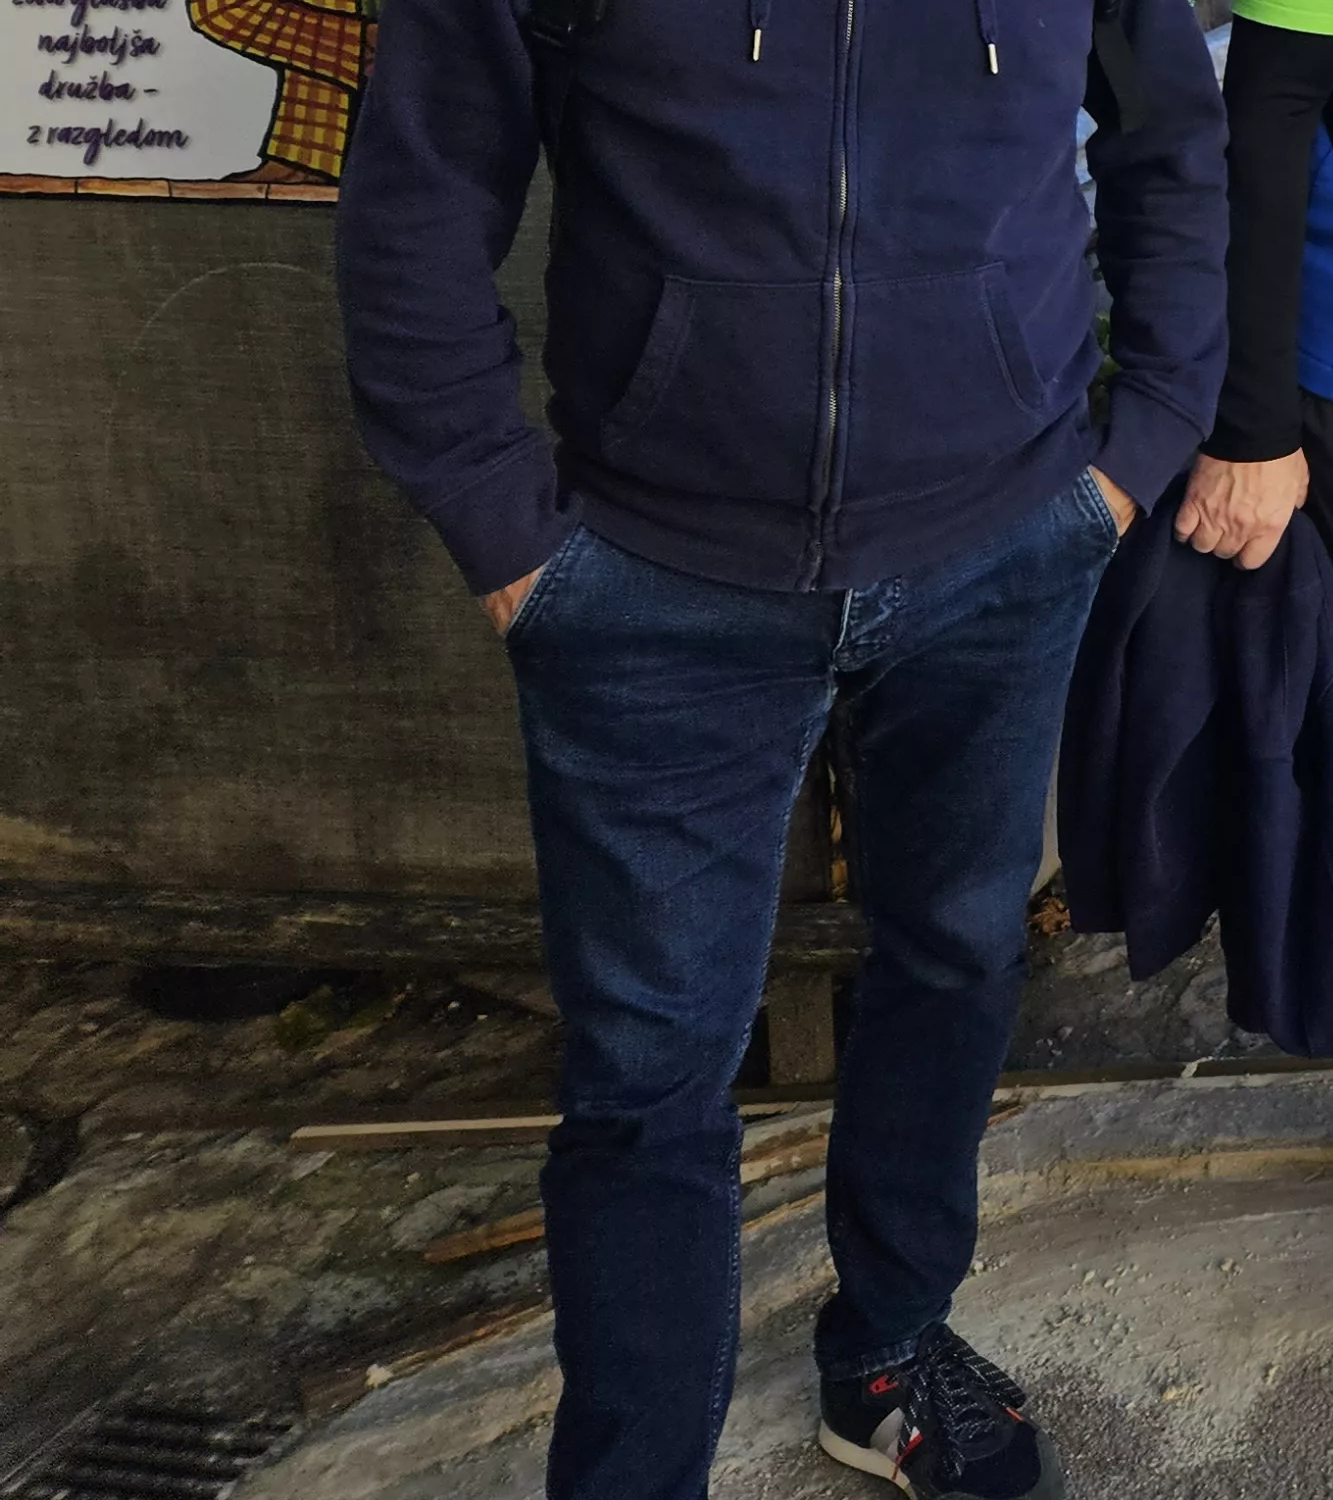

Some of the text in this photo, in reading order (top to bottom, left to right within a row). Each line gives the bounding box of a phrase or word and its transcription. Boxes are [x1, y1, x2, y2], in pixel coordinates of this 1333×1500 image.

[38, 23, 161, 66] najboljša
[38, 69, 136, 102] družba
[26, 118, 189, 166] z razgledom
